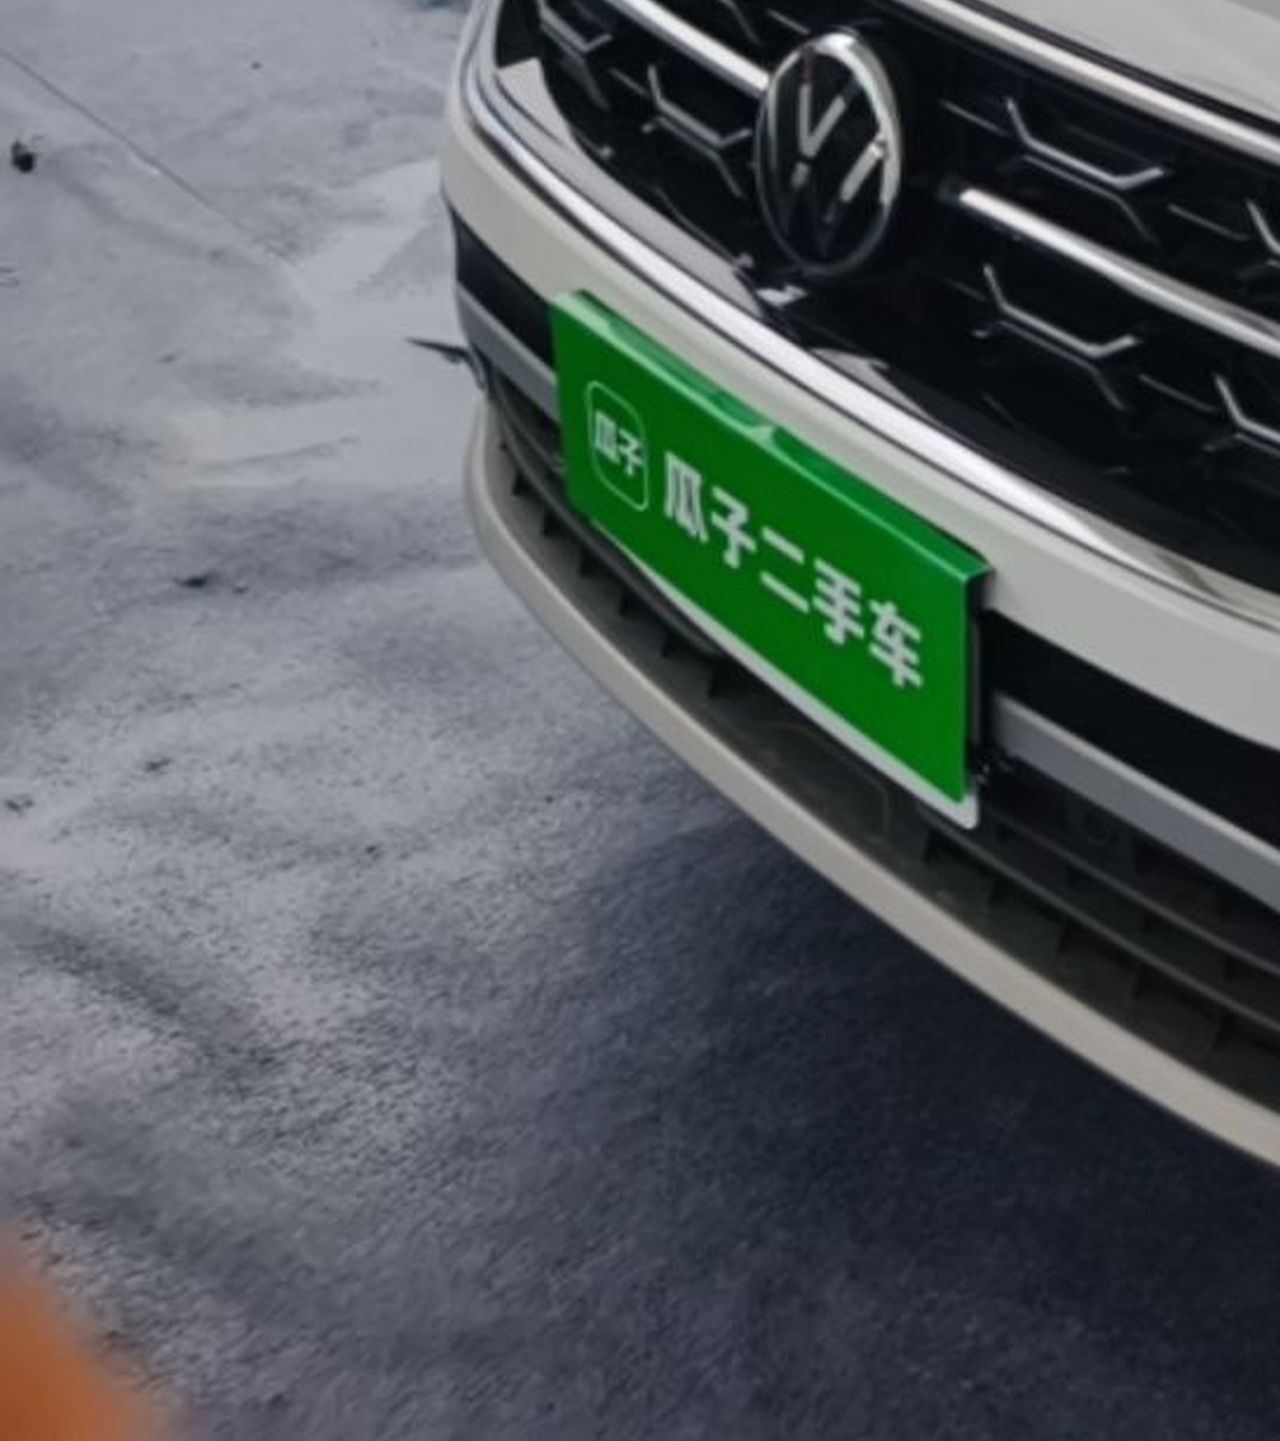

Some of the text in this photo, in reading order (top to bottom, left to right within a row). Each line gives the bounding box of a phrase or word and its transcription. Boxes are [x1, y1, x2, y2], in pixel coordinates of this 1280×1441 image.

[592, 410, 643, 477] 瓜子
[664, 451, 923, 689] 瓜子二手车
